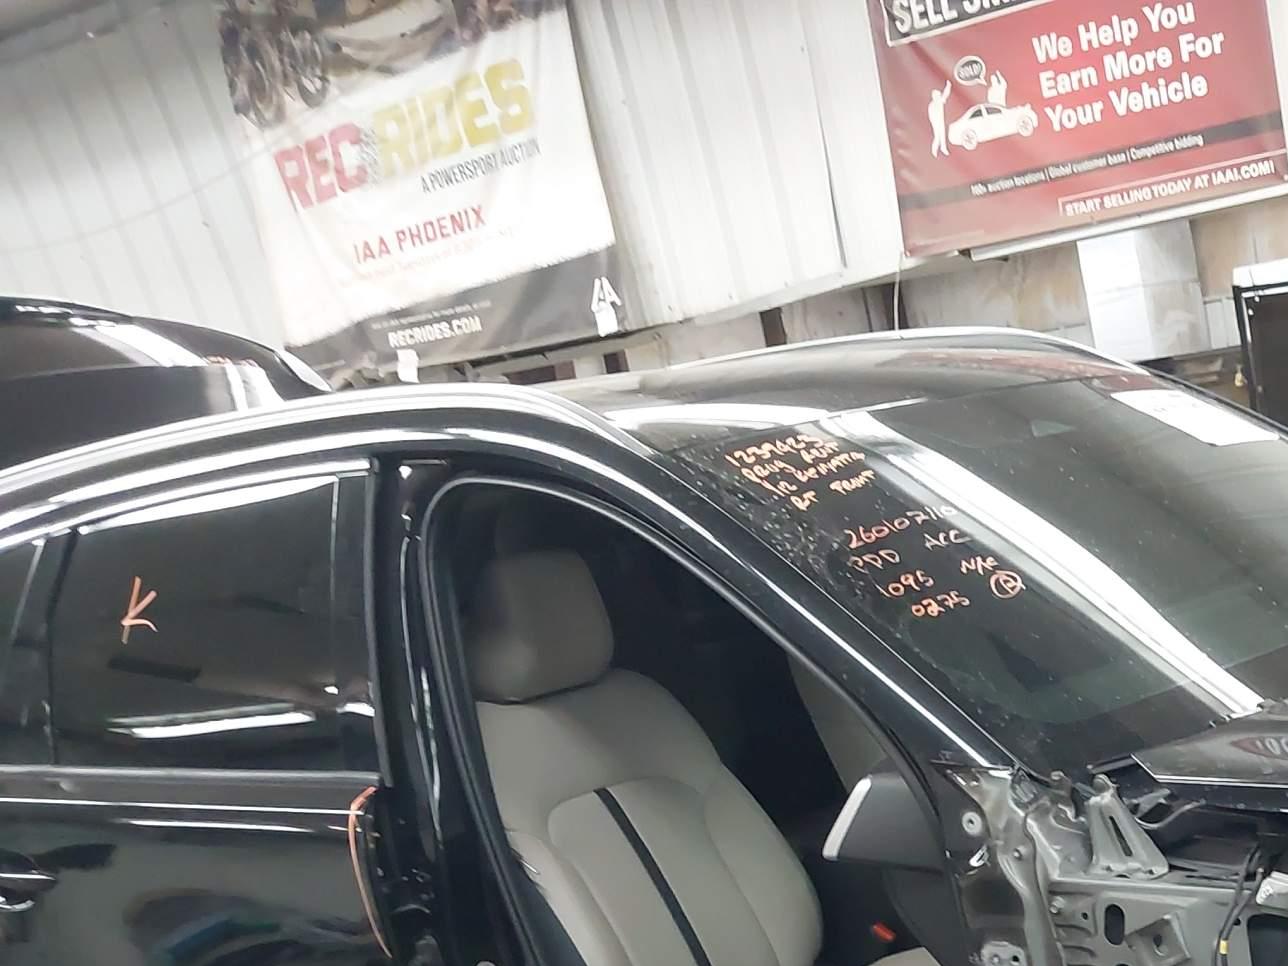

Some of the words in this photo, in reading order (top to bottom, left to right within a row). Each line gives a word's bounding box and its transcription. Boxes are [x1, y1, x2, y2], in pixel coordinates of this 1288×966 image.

[1032, 32, 1073, 63] We
[1077, 14, 1139, 51] Help
[1142, 1, 1196, 32] You
[1039, 66, 1098, 98] Earn
[1103, 47, 1173, 82] More
[1178, 32, 1225, 62] For
[1044, 100, 1104, 132] Your
[1108, 72, 1208, 116] Vehicle
[1065, 199, 1102, 216] START
[1103, 188, 1152, 209] SELLING
[1152, 180, 1191, 198] TODAY
[1194, 175, 1210, 189] AT
[353, 235, 391, 264] IAA
[395, 205, 487, 252] PHOENIX
[387, 315, 483, 348] RECRIDES.COM
